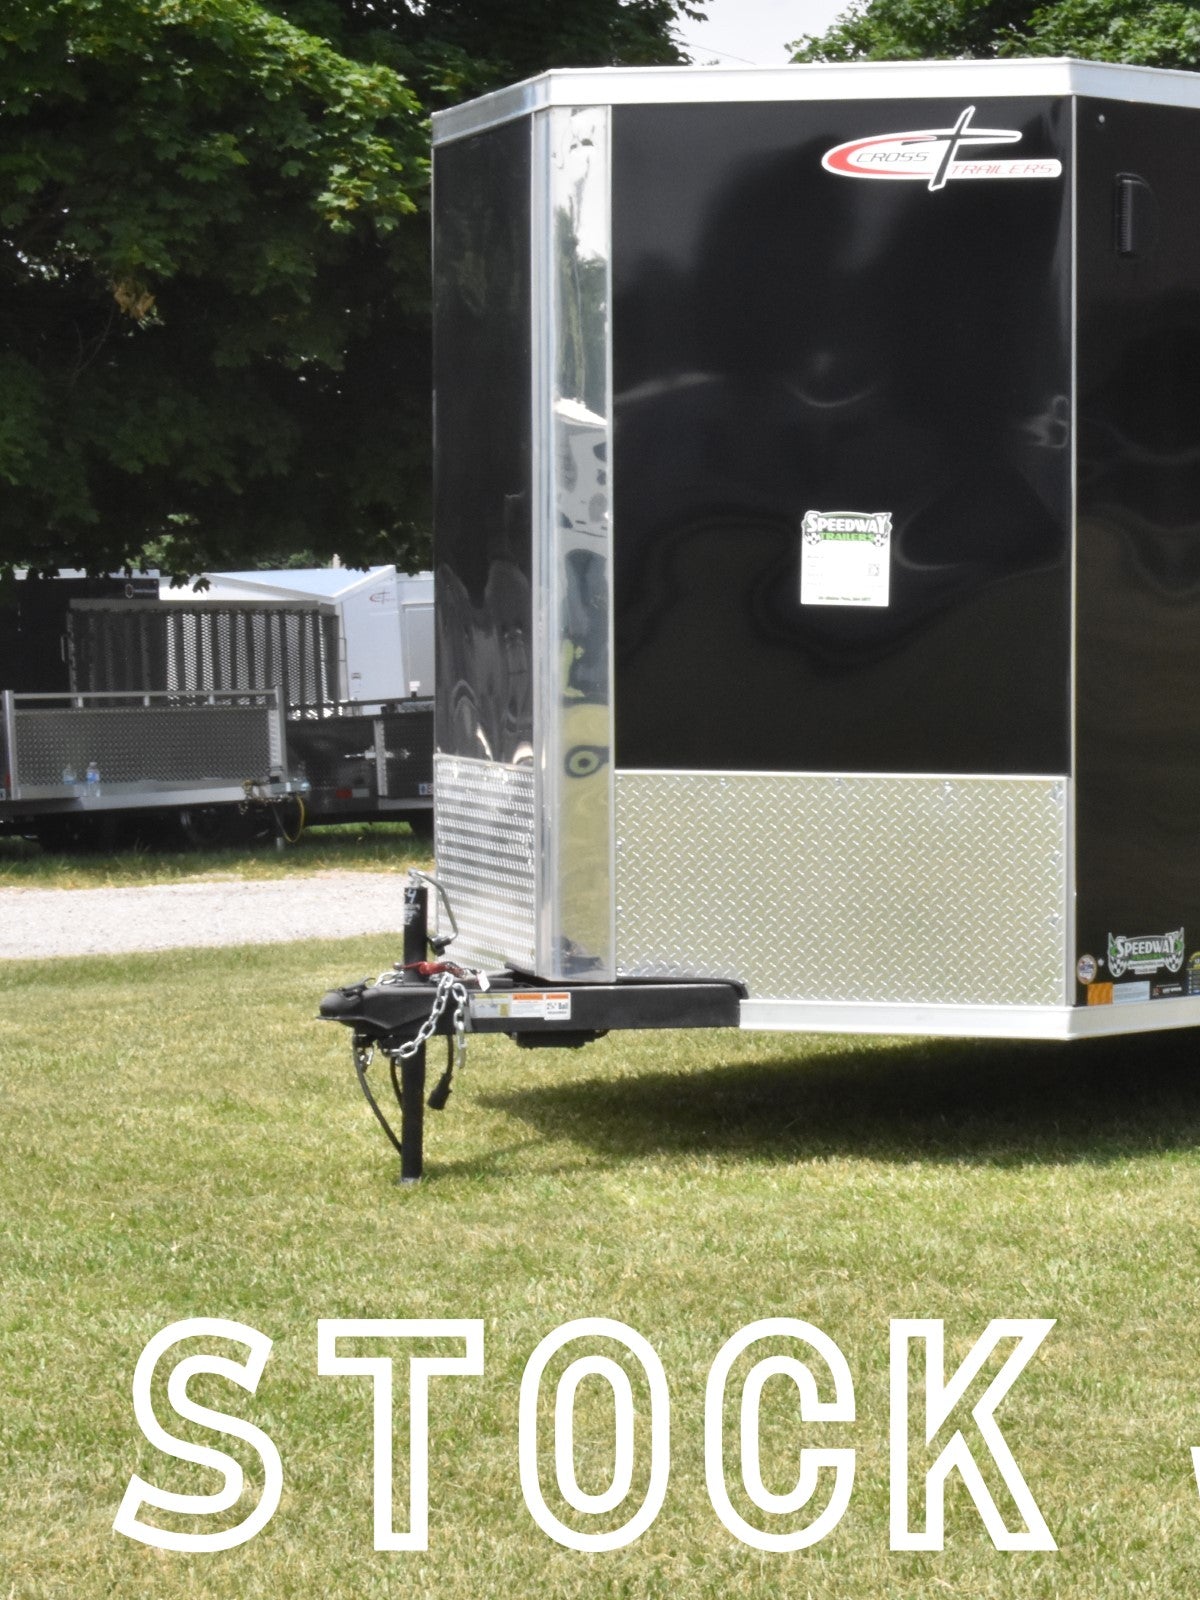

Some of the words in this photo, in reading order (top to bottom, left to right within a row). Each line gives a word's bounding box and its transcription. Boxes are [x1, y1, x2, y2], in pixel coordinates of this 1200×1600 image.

[855, 151, 929, 164] CROSS
[951, 164, 1053, 175] TRAILERS
[806, 513, 888, 534] SPEEDWAY
[821, 533, 875, 541] TRAILERS
[1116, 934, 1176, 958] SPEEDWAY
